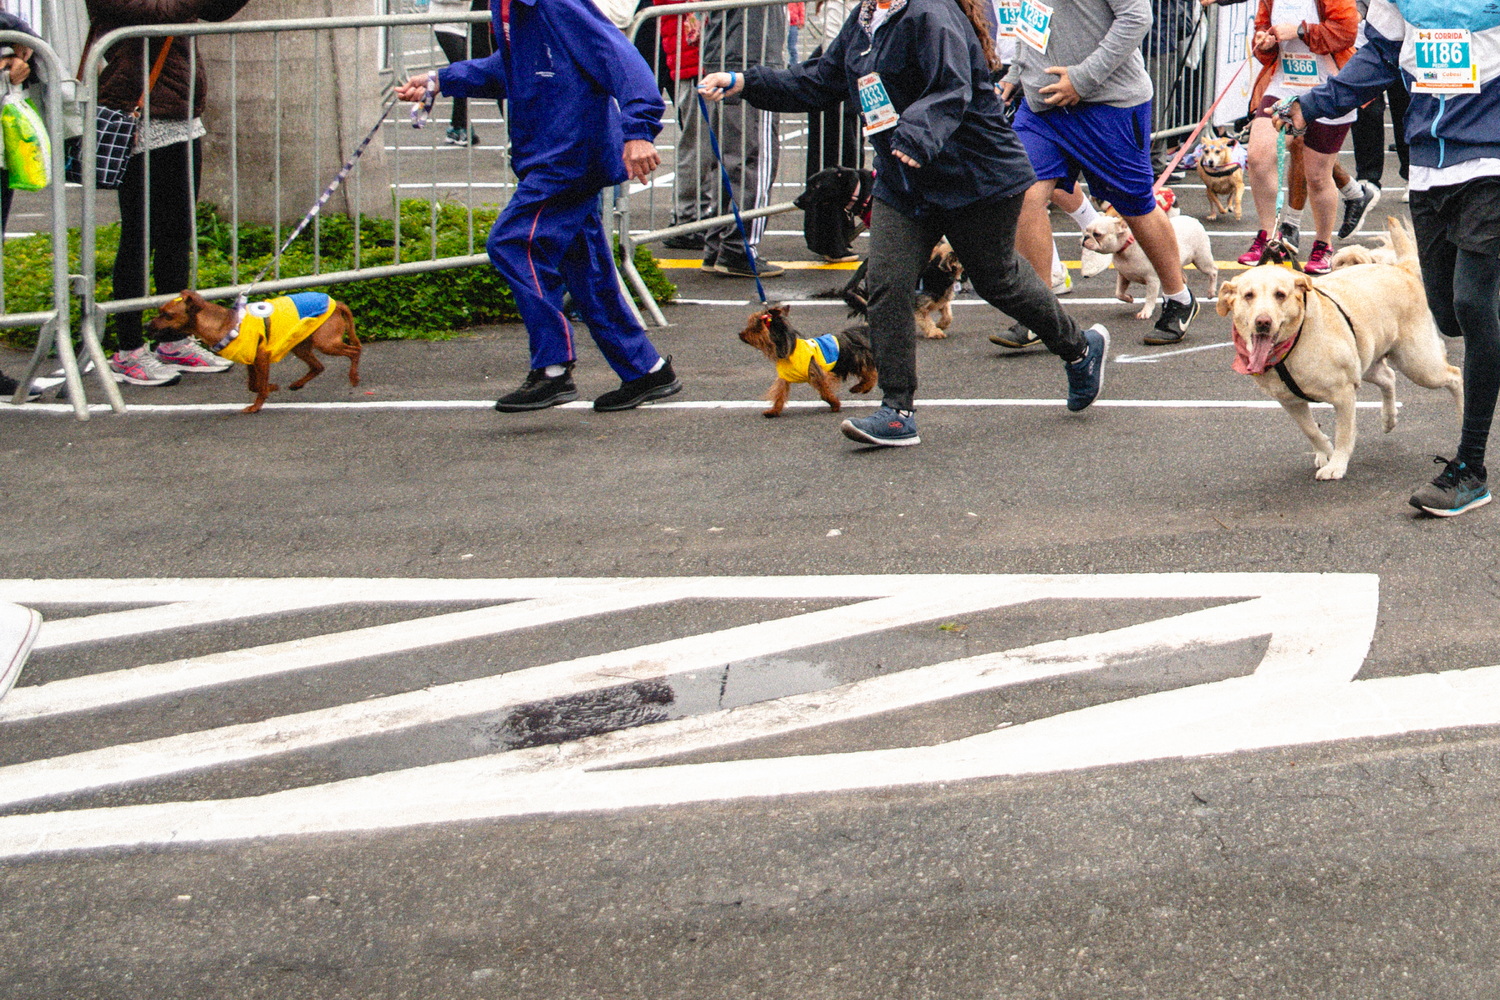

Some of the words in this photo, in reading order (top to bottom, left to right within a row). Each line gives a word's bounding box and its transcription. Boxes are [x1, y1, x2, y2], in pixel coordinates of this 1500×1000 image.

[1024, 3, 1045, 29] 1283
[1434, 32, 1463, 40] CORRIDA
[1421, 42, 1463, 64] 1186
[1286, 60, 1313, 73] 1366
[861, 84, 884, 107] 1333
